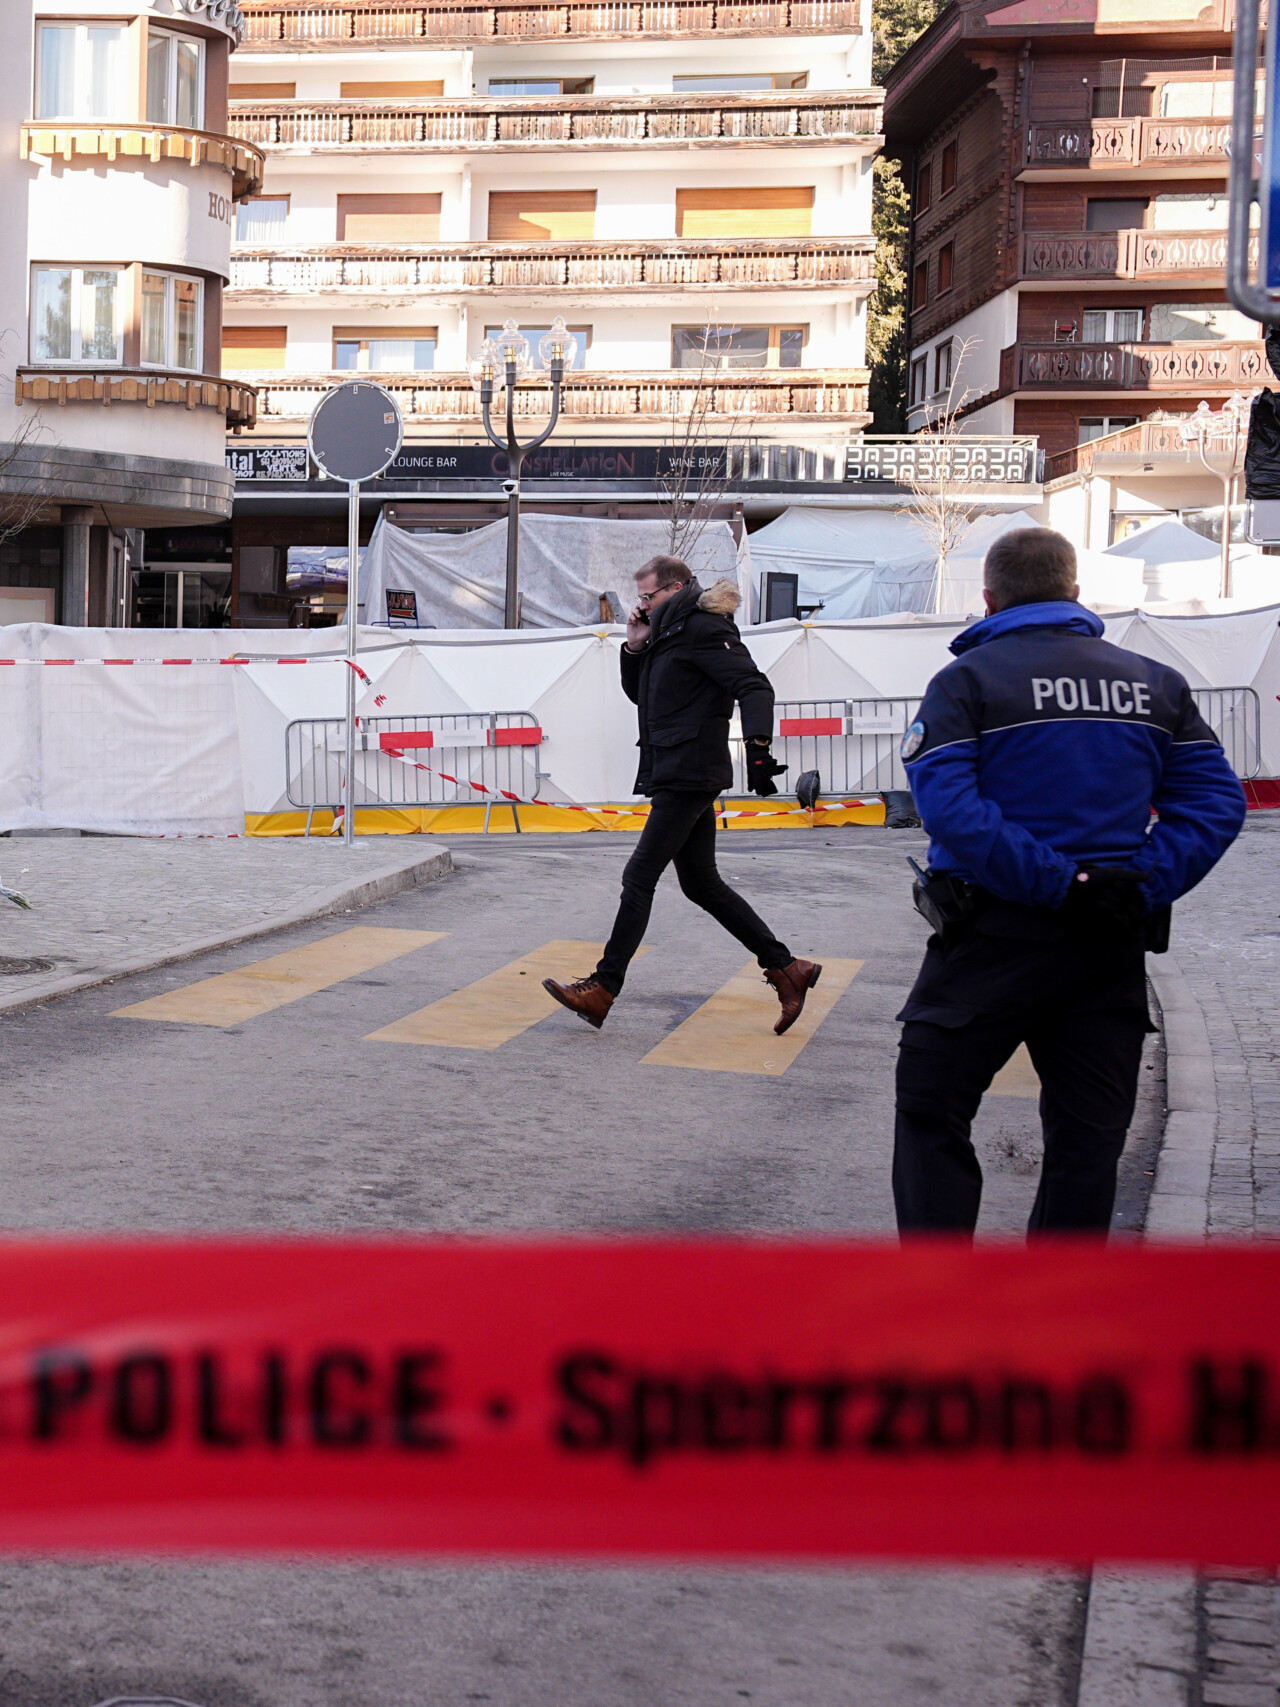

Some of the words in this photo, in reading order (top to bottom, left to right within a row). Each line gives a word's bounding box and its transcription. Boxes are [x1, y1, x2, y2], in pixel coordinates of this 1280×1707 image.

[208, 191, 232, 227] HOT
[392, 456, 434, 468] LOUNGE
[436, 456, 457, 468] BAR
[491, 451, 636, 475] CNSTELLATION
[668, 457, 696, 468] WINE
[698, 457, 719, 468] BAR
[1031, 676, 1152, 715] POLICE
[28, 1346, 458, 1452] POLICE
[552, 1348, 1136, 1470] Sperrzone
